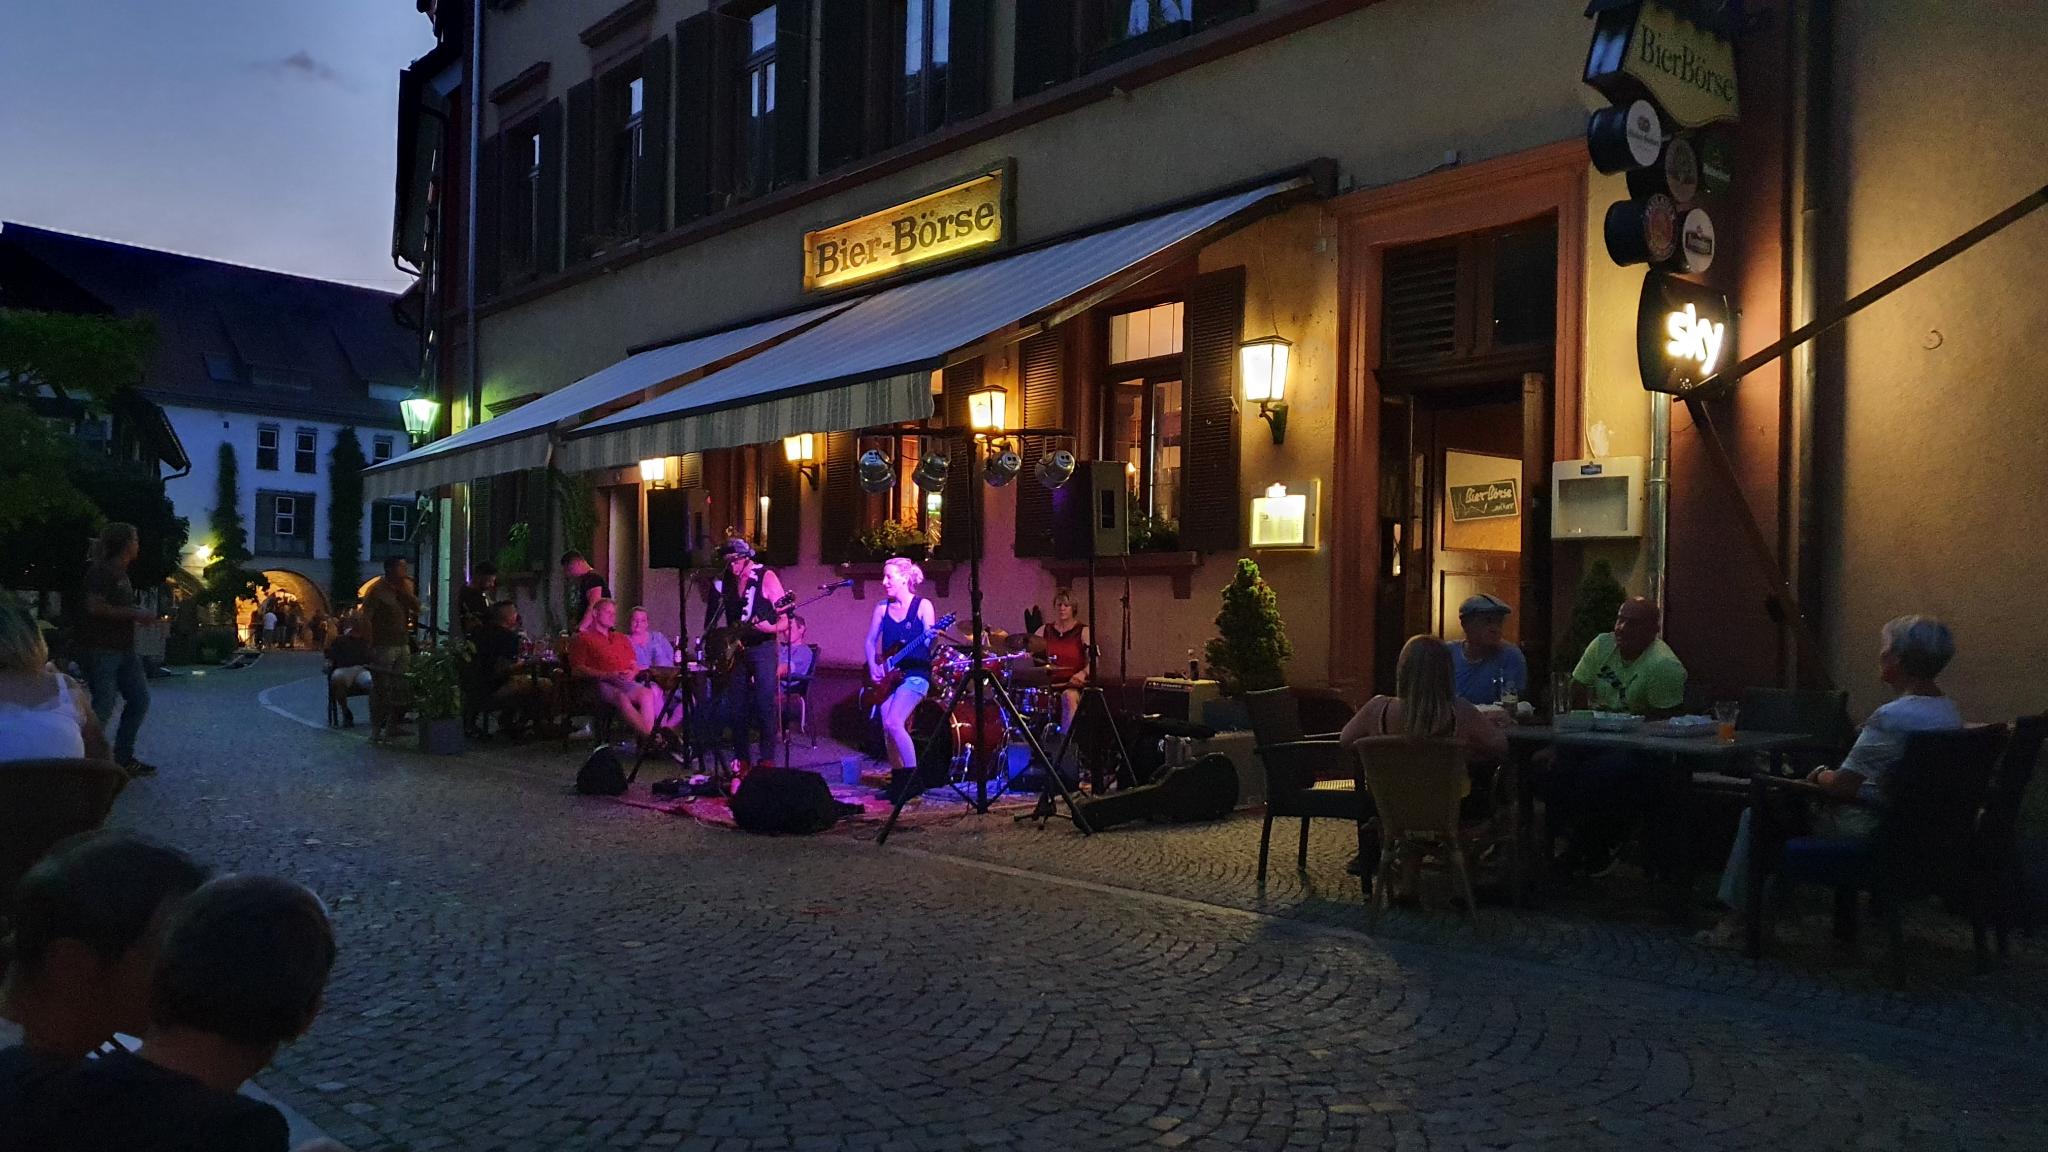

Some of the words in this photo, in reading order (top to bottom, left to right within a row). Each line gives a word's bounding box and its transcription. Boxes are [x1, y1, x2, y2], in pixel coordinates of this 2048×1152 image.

[1640, 24, 1733, 101] BierBörse
[816, 202, 994, 277] Bier-Börse
[1666, 303, 1724, 375] sky
